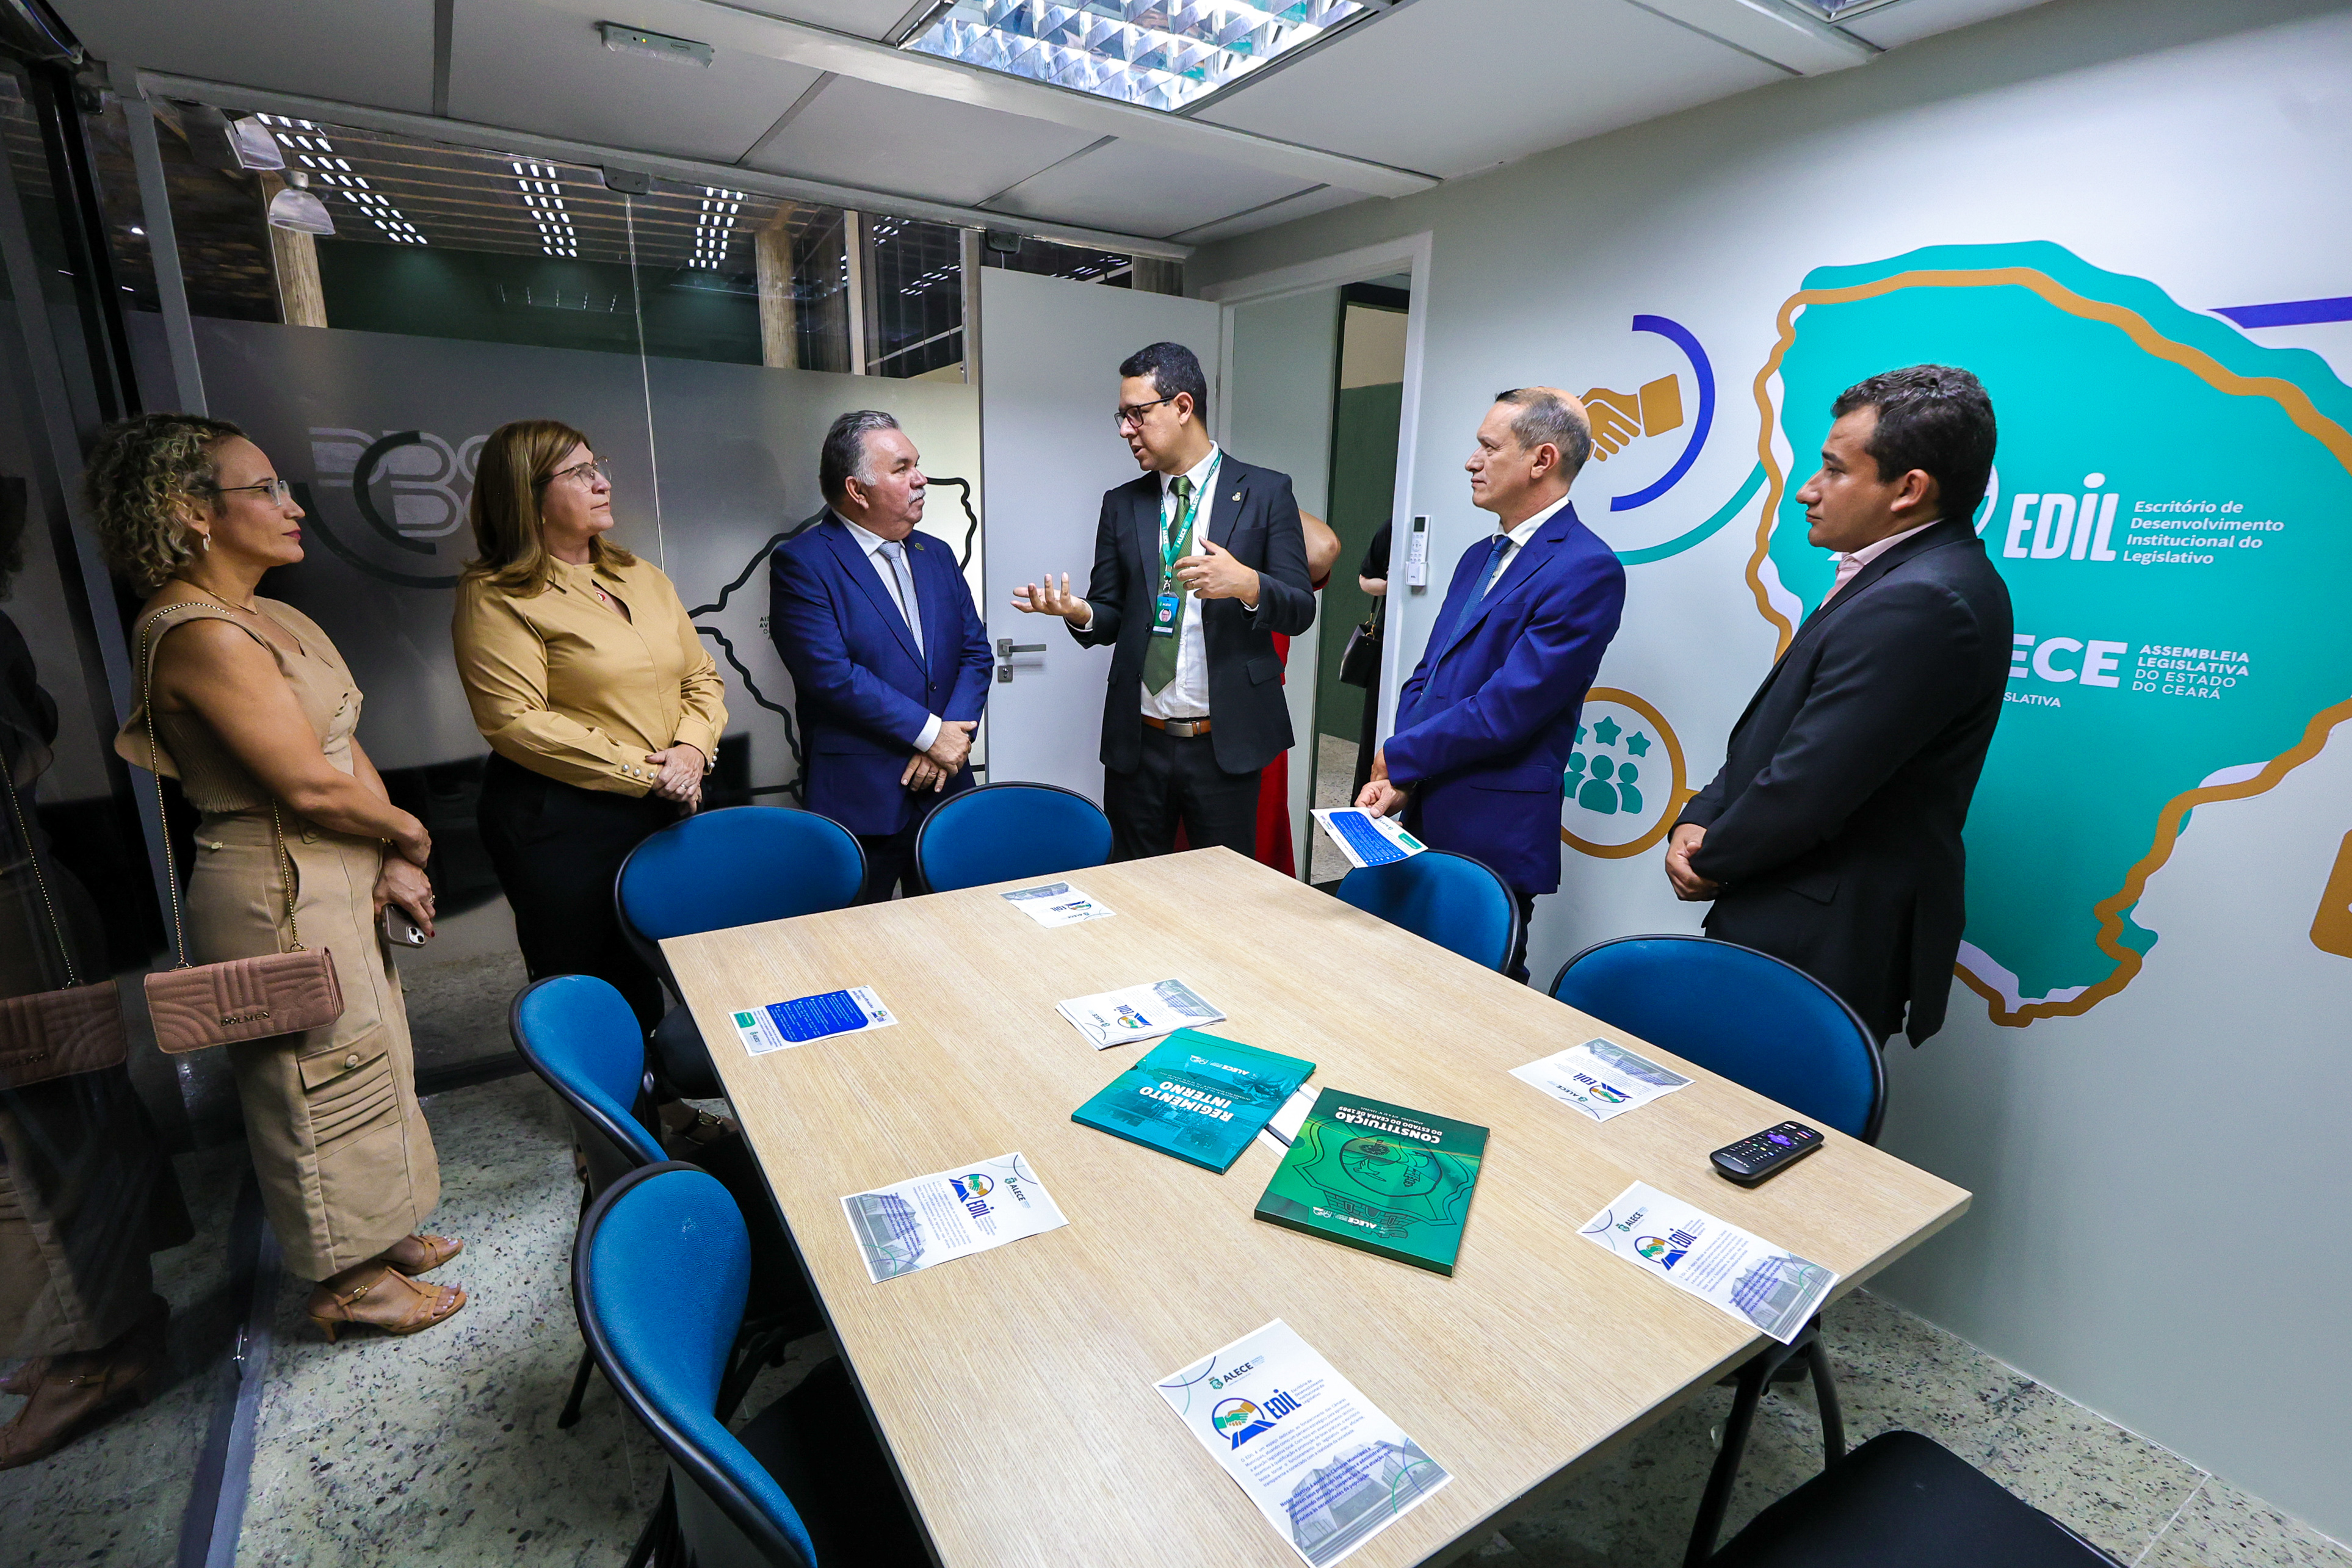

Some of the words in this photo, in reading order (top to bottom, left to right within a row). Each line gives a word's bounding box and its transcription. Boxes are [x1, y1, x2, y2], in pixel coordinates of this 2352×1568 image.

[2134, 499, 2217, 513] Escritório
[2220, 500, 2243, 513] de
[2130, 518, 2285, 531] Desenvolvimento
[1177, 527, 1187, 544] ALECE
[2126, 533, 2235, 548] Institucional
[2238, 535, 2263, 548] do
[2123, 550, 2215, 565] Legislativo
[2008, 634, 2128, 688] ECE
[2139, 645, 2249, 663] ASSEMBLEIA
[2137, 657, 2249, 676] LEGISLATIVA
[2135, 669, 2159, 680] DO
[2165, 672, 2236, 687] ESTADO
[2132, 681, 2157, 692] DO
[2162, 684, 2220, 699] CEARÁ
[1221, 1064, 1250, 1075] ALECE
[1159, 1082, 1232, 1108] INTERNO
[1556, 1085, 1579, 1096] ALECE
[1139, 1086, 1234, 1122] REGIMENTO
[1366, 1113, 1389, 1121] CEARÁ
[1335, 1111, 1440, 1144] CONSTITUIÇÃO
[1402, 1122, 1430, 1132] ESTADO
[1010, 1185, 1026, 1201] ALECE
[1348, 1217, 1377, 1229] ALECE
[1625, 1212, 1643, 1227] ALECE
[1223, 1362, 1253, 1382] ALECE
